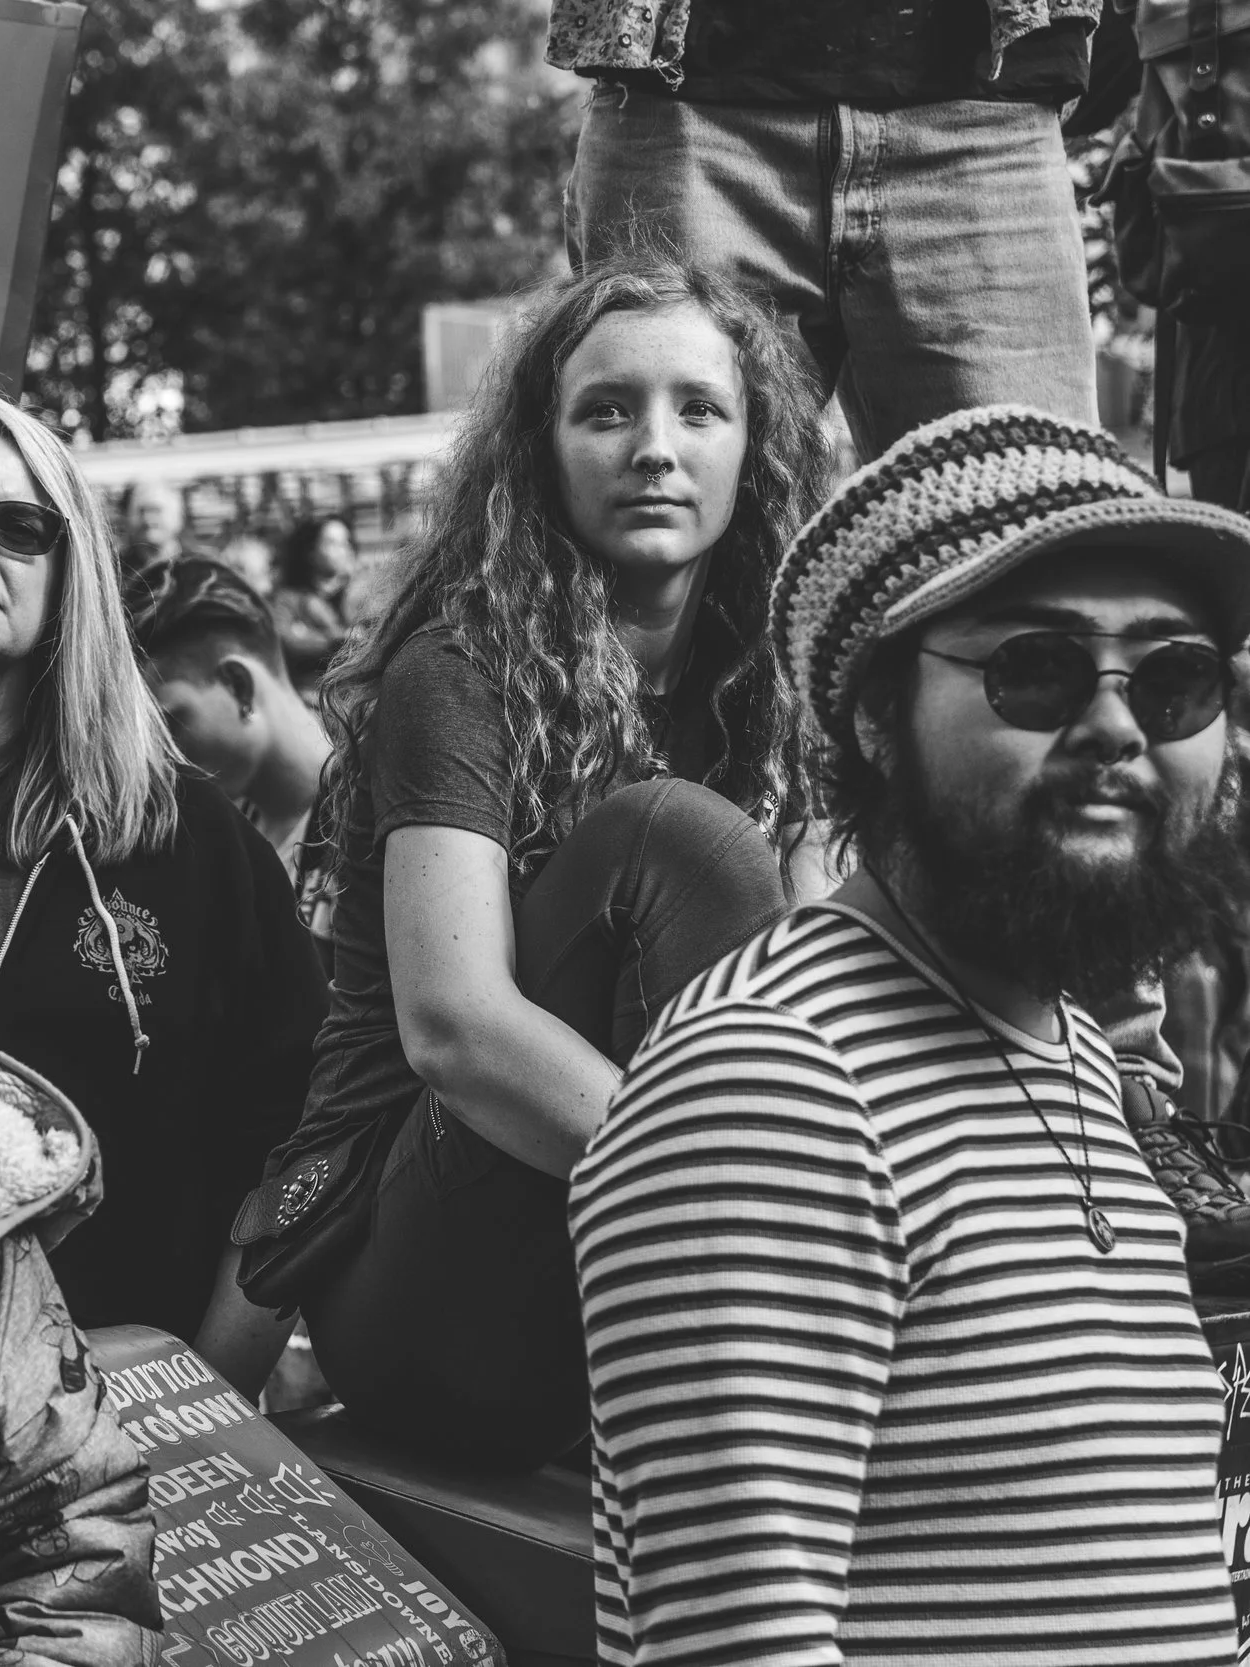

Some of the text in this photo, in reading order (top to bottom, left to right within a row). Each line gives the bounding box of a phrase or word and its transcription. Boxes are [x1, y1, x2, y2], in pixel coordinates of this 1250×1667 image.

[157, 1532, 320, 1621] CHMOND
[206, 1573, 383, 1667] COQUITLAM
[288, 1511, 455, 1666] LANSDOWNE
